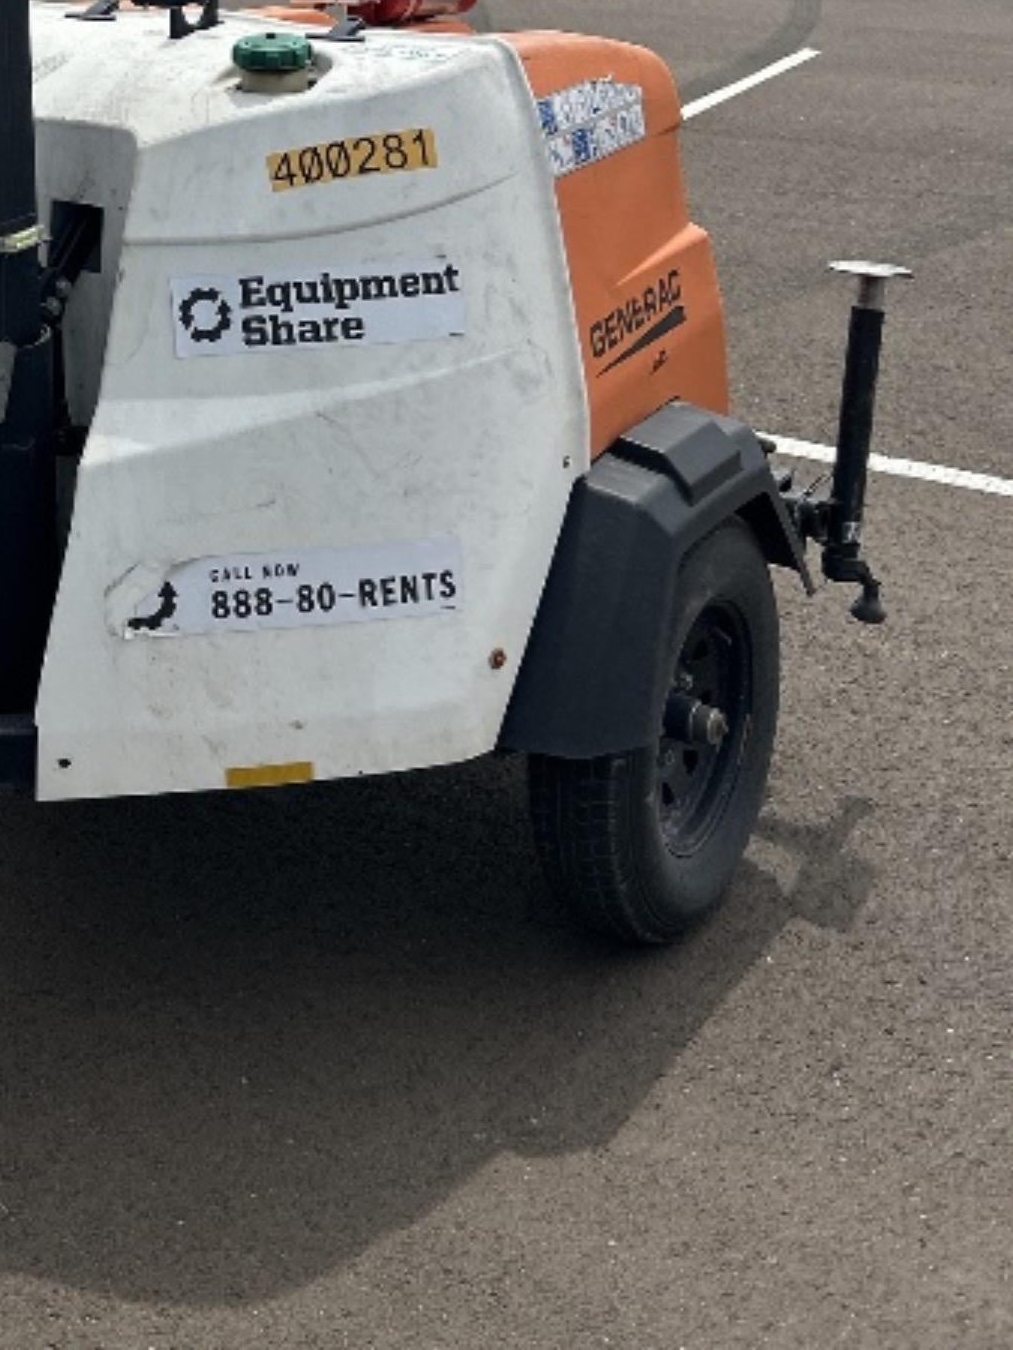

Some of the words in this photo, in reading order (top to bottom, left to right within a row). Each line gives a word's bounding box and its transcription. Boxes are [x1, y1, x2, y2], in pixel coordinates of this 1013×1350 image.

[273, 128, 429, 187] 400281
[238, 263, 460, 313] Equipment
[588, 268, 681, 358] GENERAC
[241, 314, 365, 347] Share
[209, 566, 253, 583] CALL
[261, 562, 301, 580] NOW
[211, 569, 457, 619] 888-80-RENTS
